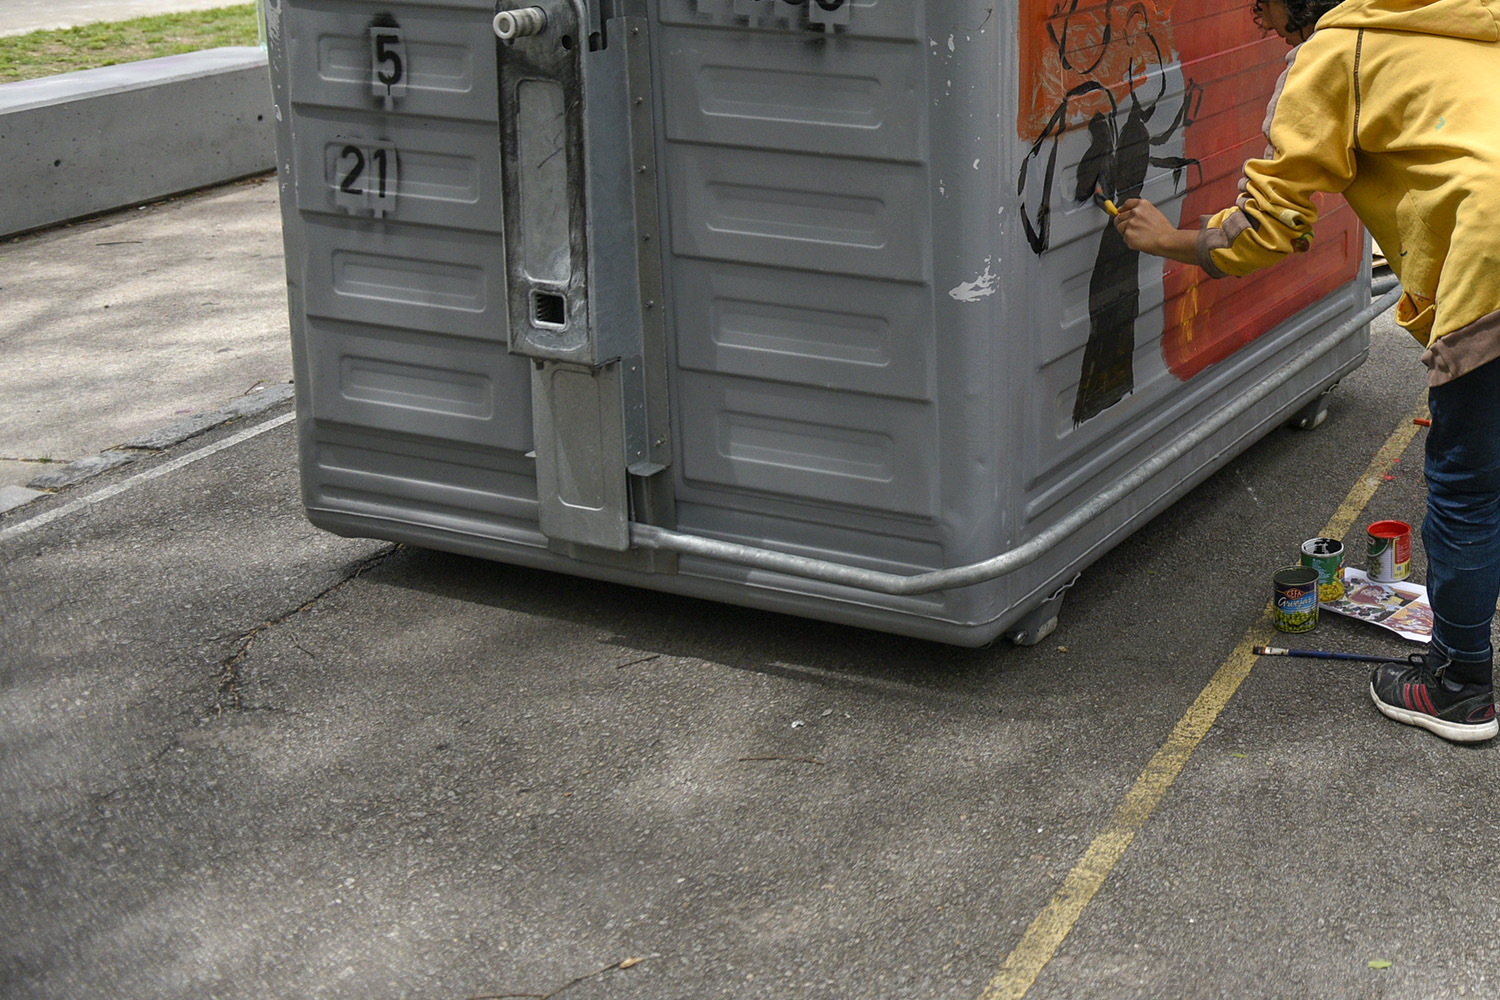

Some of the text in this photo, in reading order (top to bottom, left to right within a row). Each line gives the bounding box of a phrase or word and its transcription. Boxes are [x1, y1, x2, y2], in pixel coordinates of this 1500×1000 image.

[375, 33, 402, 88] 5
[340, 145, 387, 199] 21
[1286, 589, 1302, 598] CEFA
